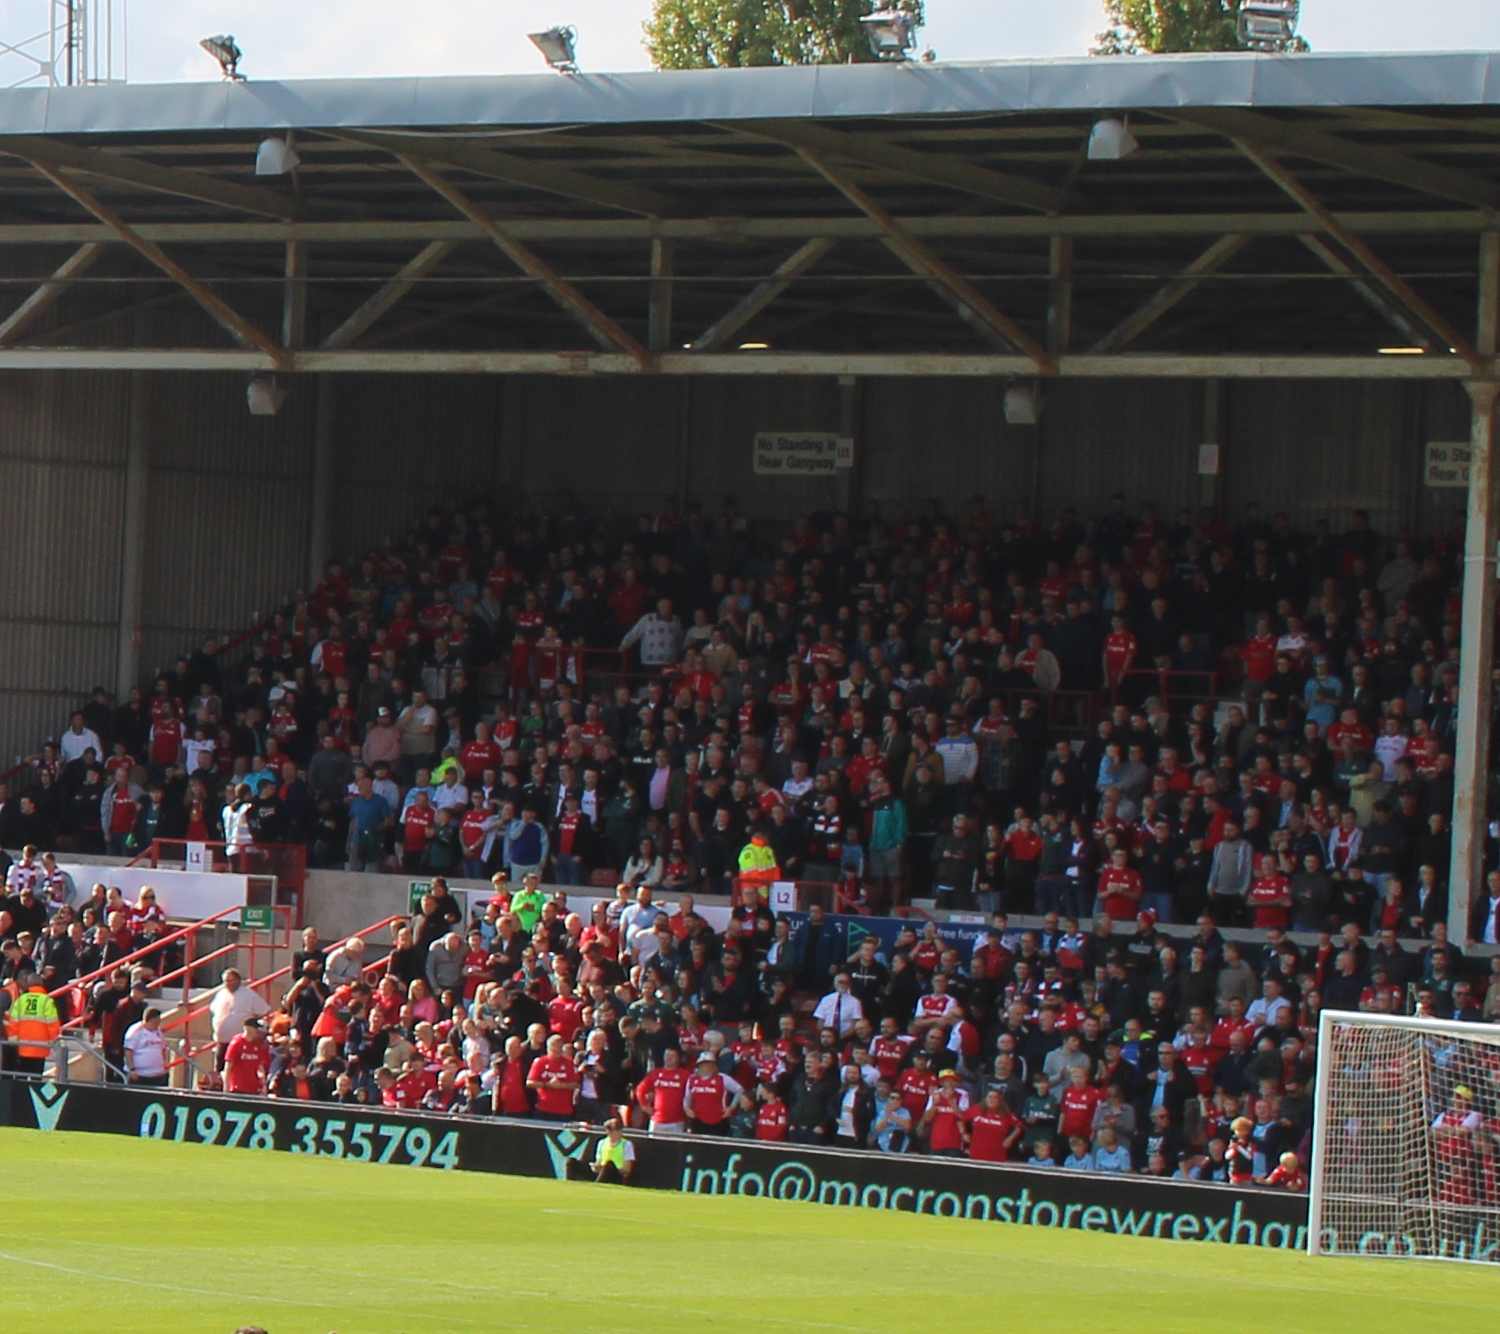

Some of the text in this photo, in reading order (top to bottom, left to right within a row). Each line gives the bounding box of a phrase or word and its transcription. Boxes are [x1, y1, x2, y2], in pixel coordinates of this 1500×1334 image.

[758, 437, 773, 451] No
[777, 437, 823, 453] Standing
[190, 852, 201, 864] L1
[777, 891, 790, 904] L2
[247, 909, 264, 919] EXIT
[140, 1102, 461, 1170] 01978 355794
